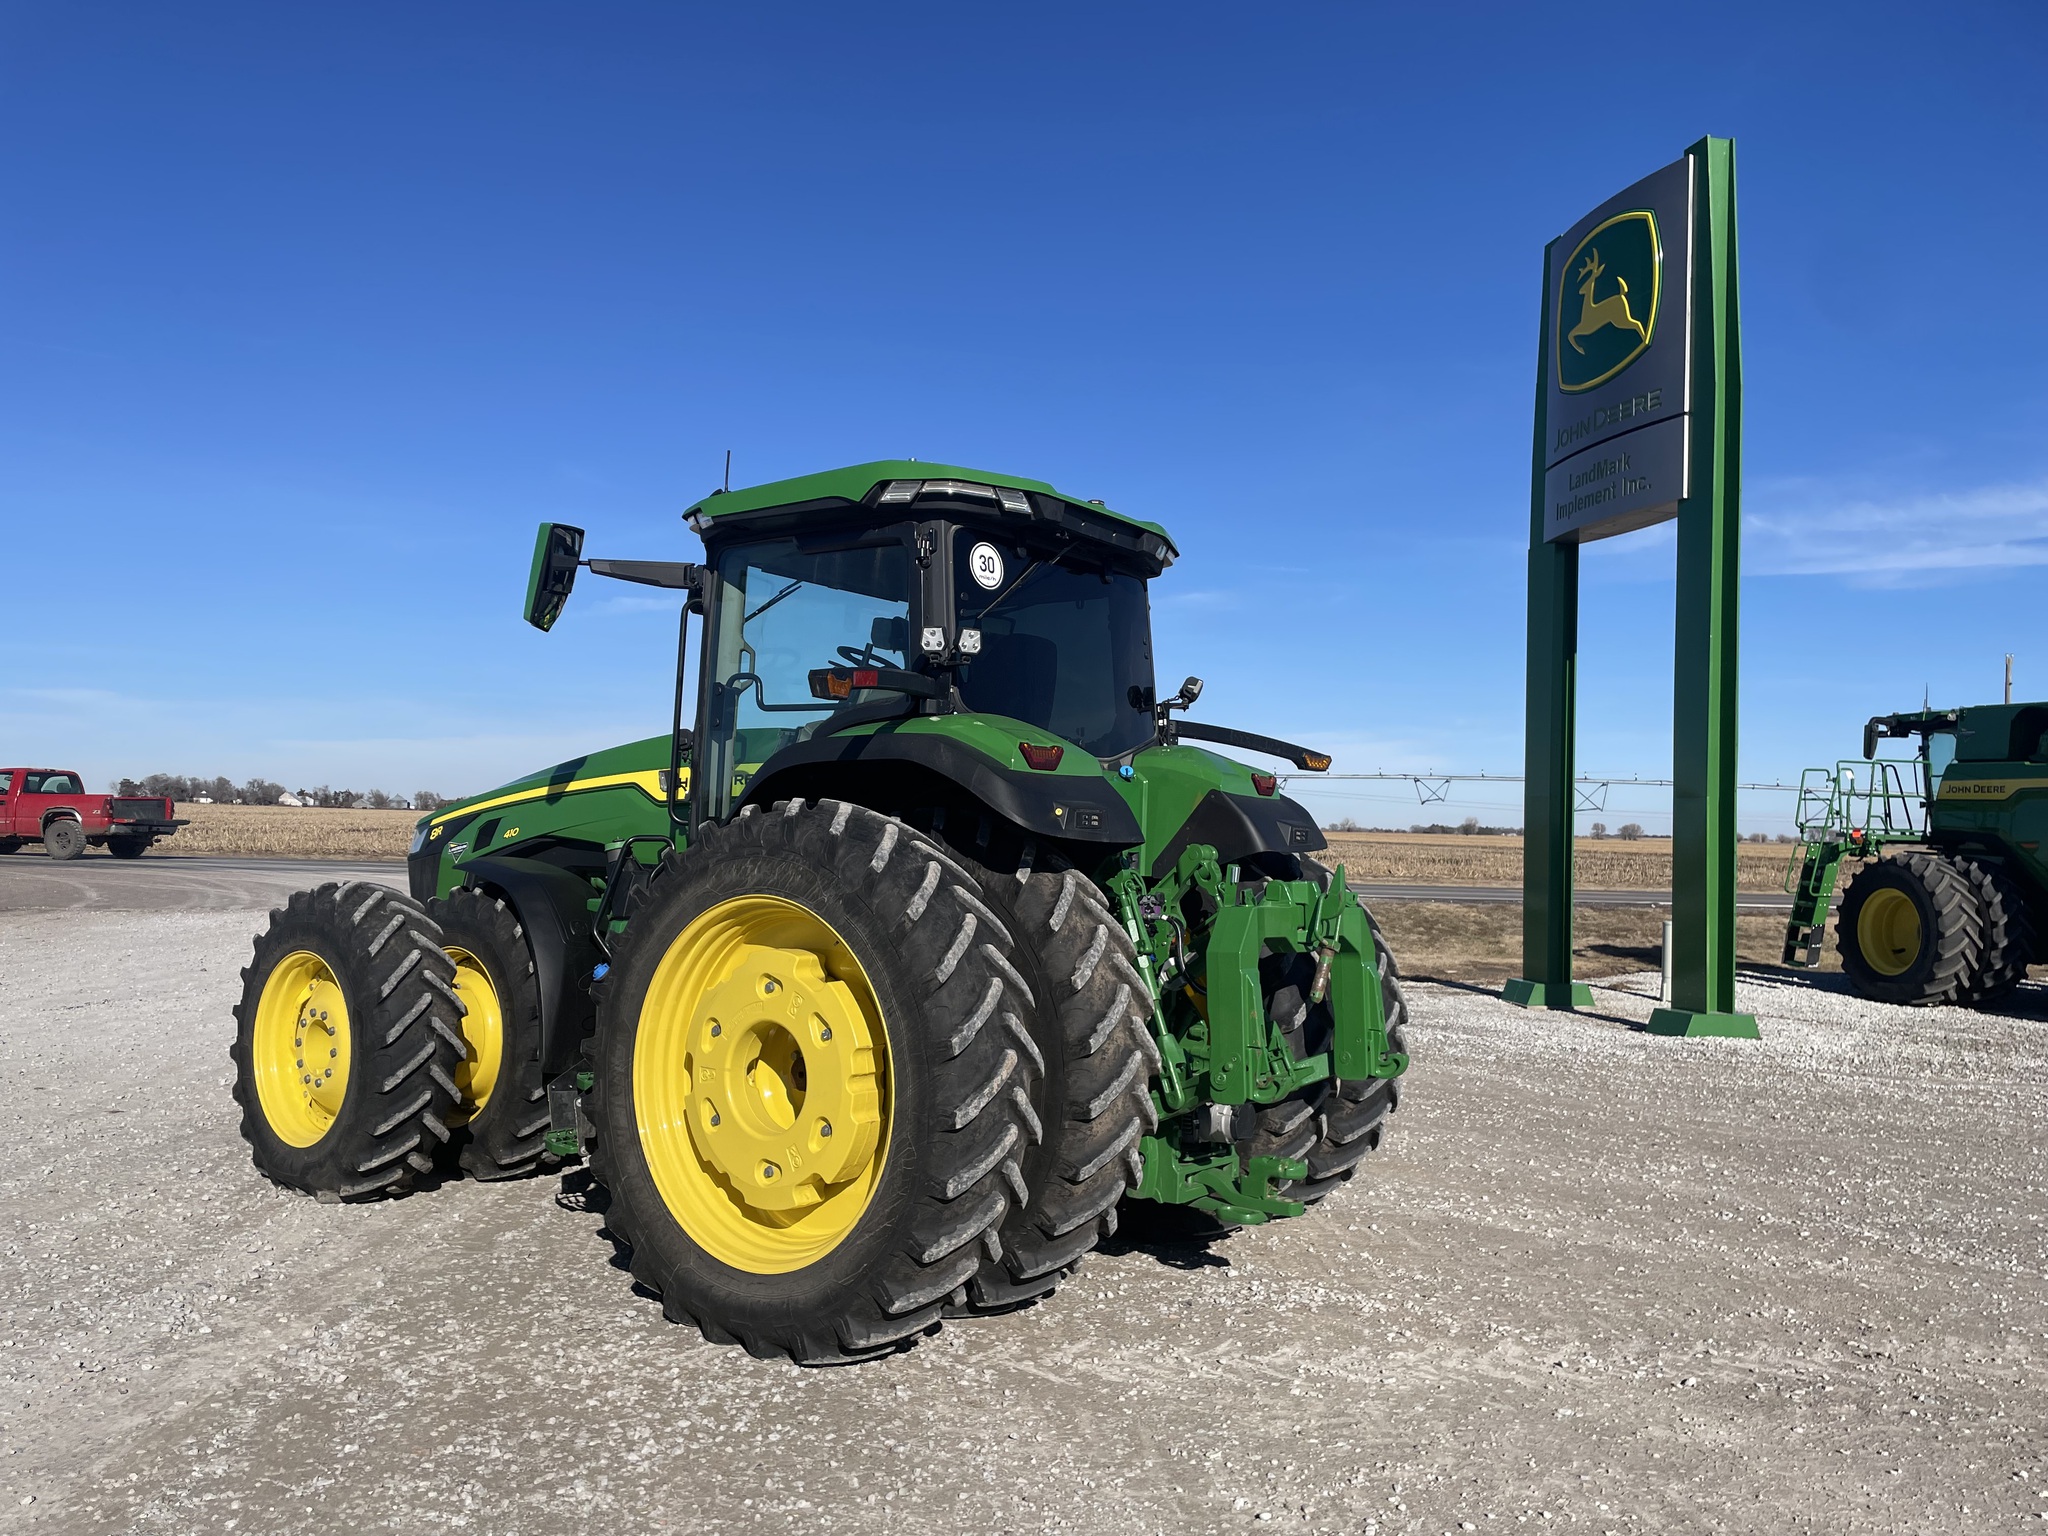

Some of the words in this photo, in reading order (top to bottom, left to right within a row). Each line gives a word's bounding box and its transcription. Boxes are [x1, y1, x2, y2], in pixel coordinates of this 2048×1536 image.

[1554, 416, 1591, 452] JOHN
[1593, 388, 1663, 429] DEERE
[1569, 453, 1631, 492] LandMark
[1556, 483, 1617, 521] Implement
[1621, 476, 1652, 497] Inc.
[979, 554, 995, 574] 30
[1946, 784, 1971, 794] JOHN
[1973, 784, 2006, 794] DEERE
[429, 825, 444, 841] 8R
[503, 827, 520, 839] 410
